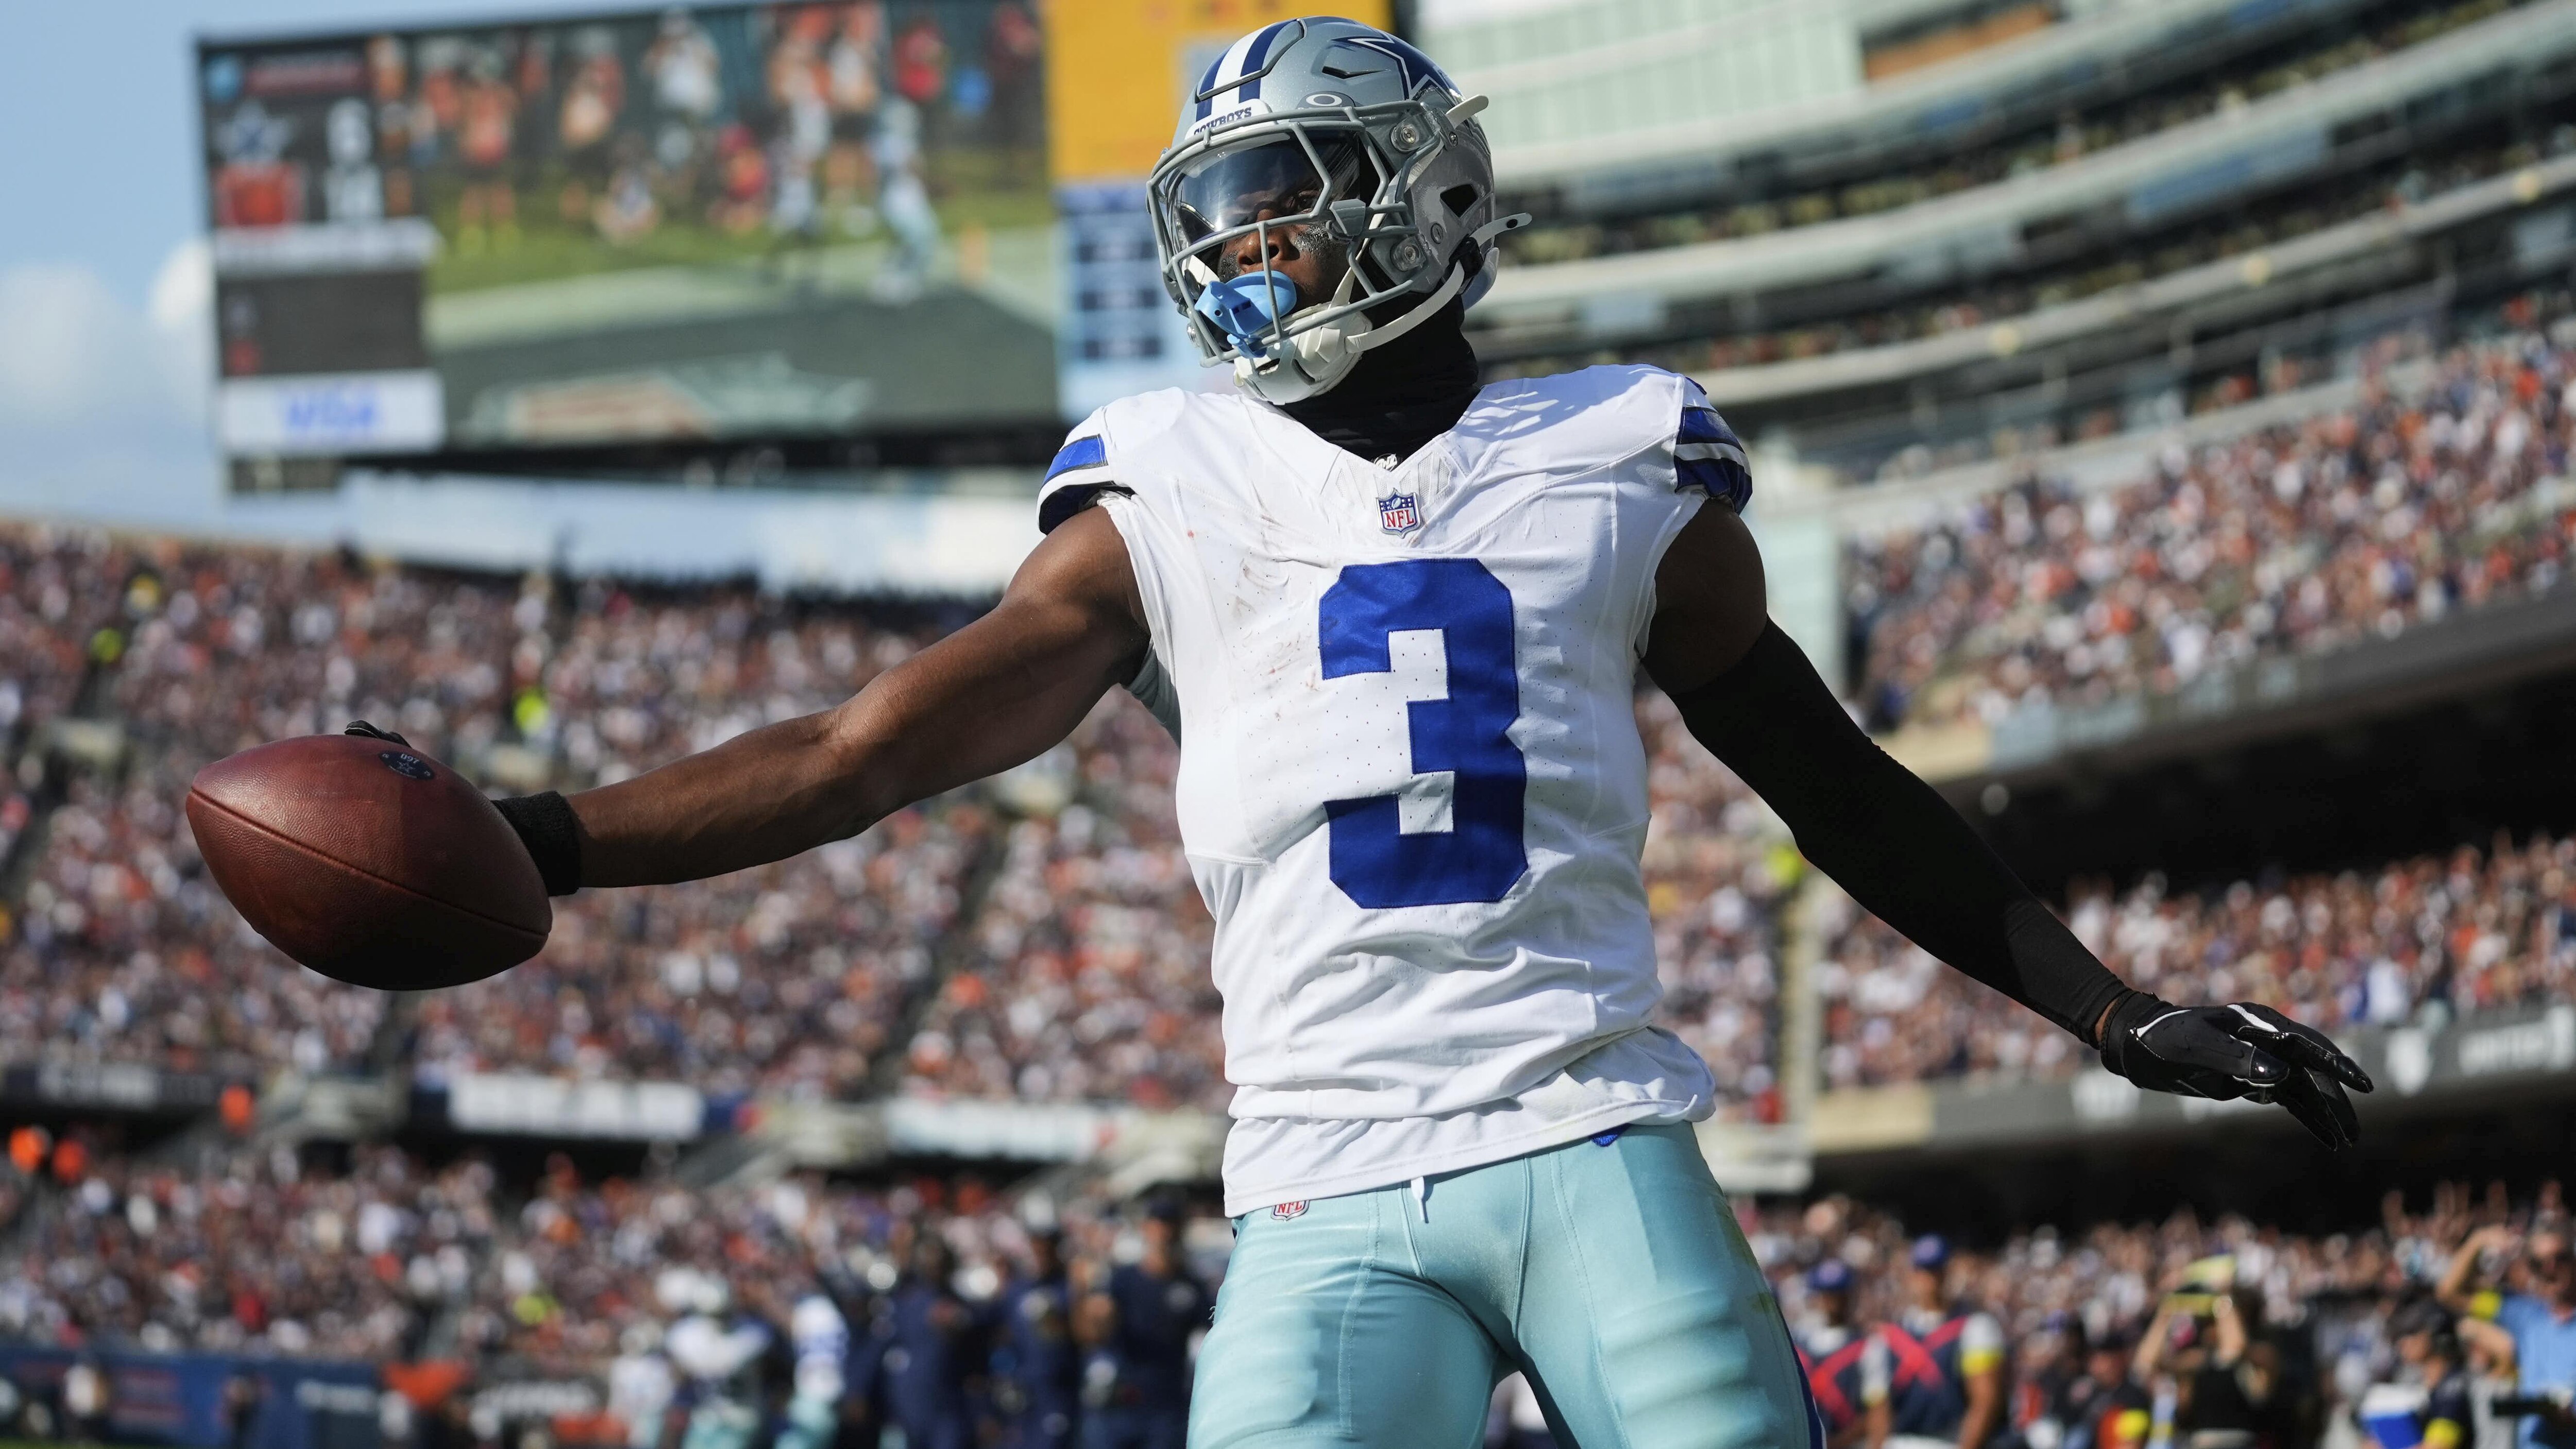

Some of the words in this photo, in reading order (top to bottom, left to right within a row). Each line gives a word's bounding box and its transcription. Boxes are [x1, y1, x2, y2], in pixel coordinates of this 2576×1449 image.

[1385, 509, 1414, 528] NFL
[1319, 558, 1529, 909] 3
[1277, 1201, 1302, 1214] NFL
